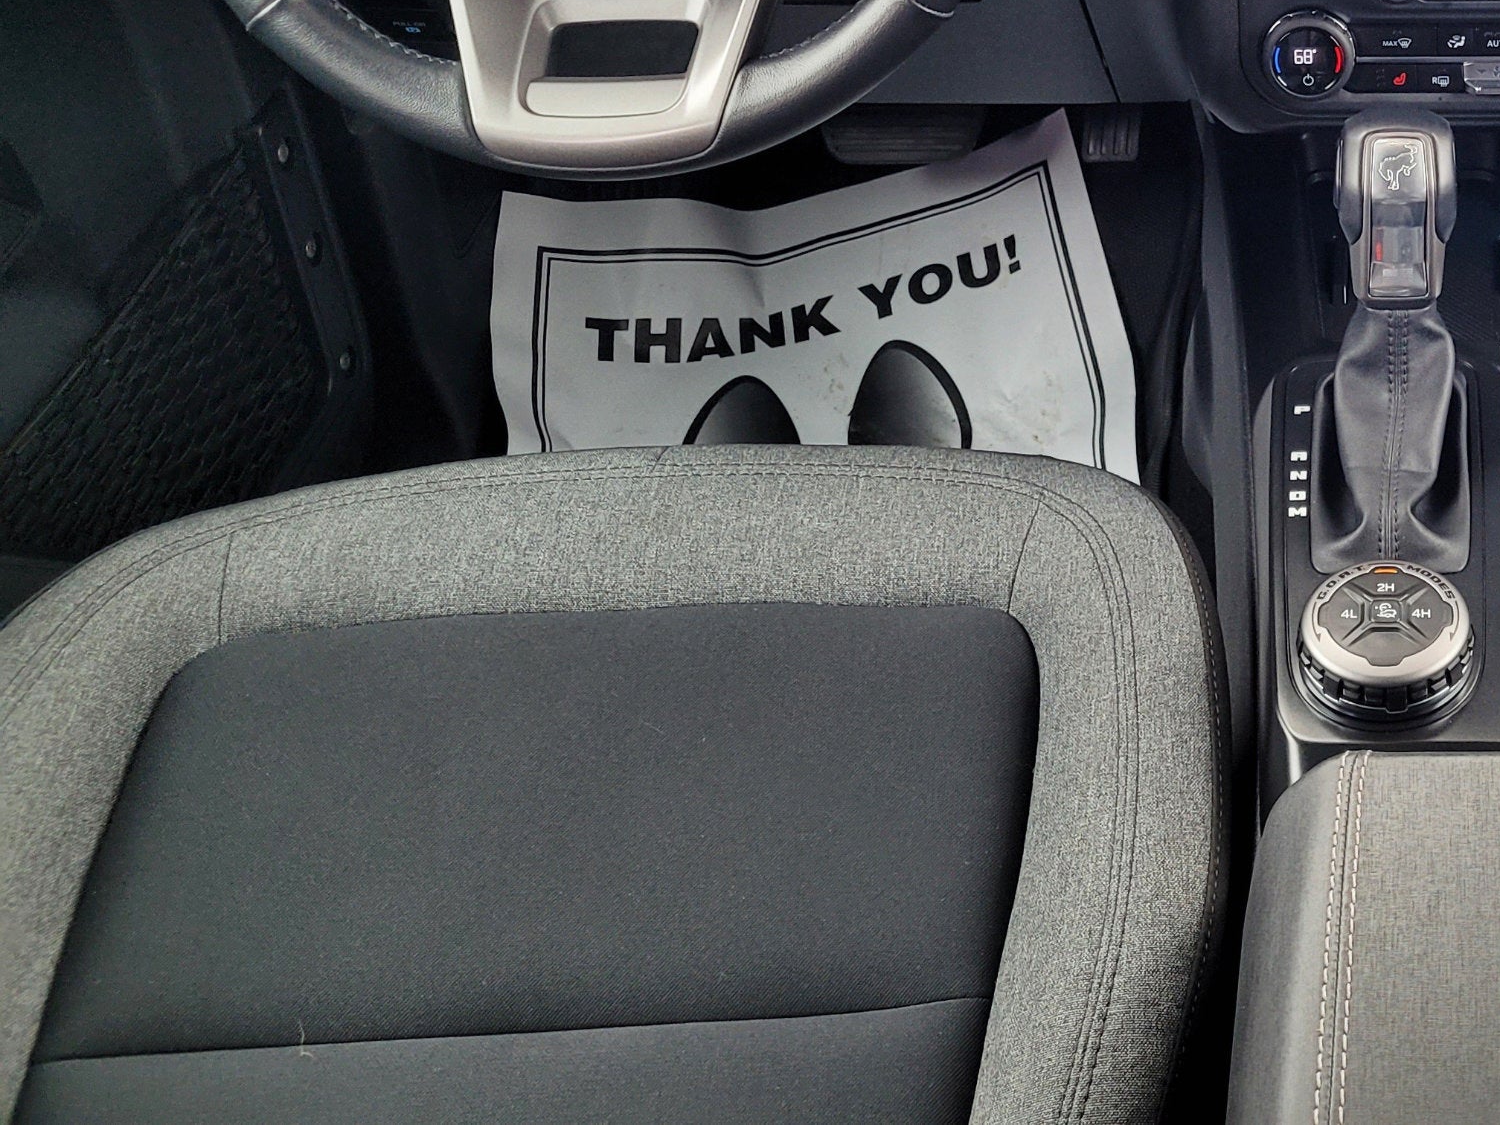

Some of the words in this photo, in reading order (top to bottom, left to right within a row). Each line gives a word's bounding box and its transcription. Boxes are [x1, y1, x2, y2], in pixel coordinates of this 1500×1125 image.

[1382, 39, 1398, 47] MAX
[585, 295, 841, 364] THANK
[858, 234, 1022, 320] YOU!
[1289, 470, 1308, 481] N
[1287, 506, 1308, 517] M
[1406, 563, 1456, 600] MODES
[1376, 583, 1395, 592] 2H
[1340, 609, 1358, 619] 4L
[1411, 608, 1431, 618] 4H
